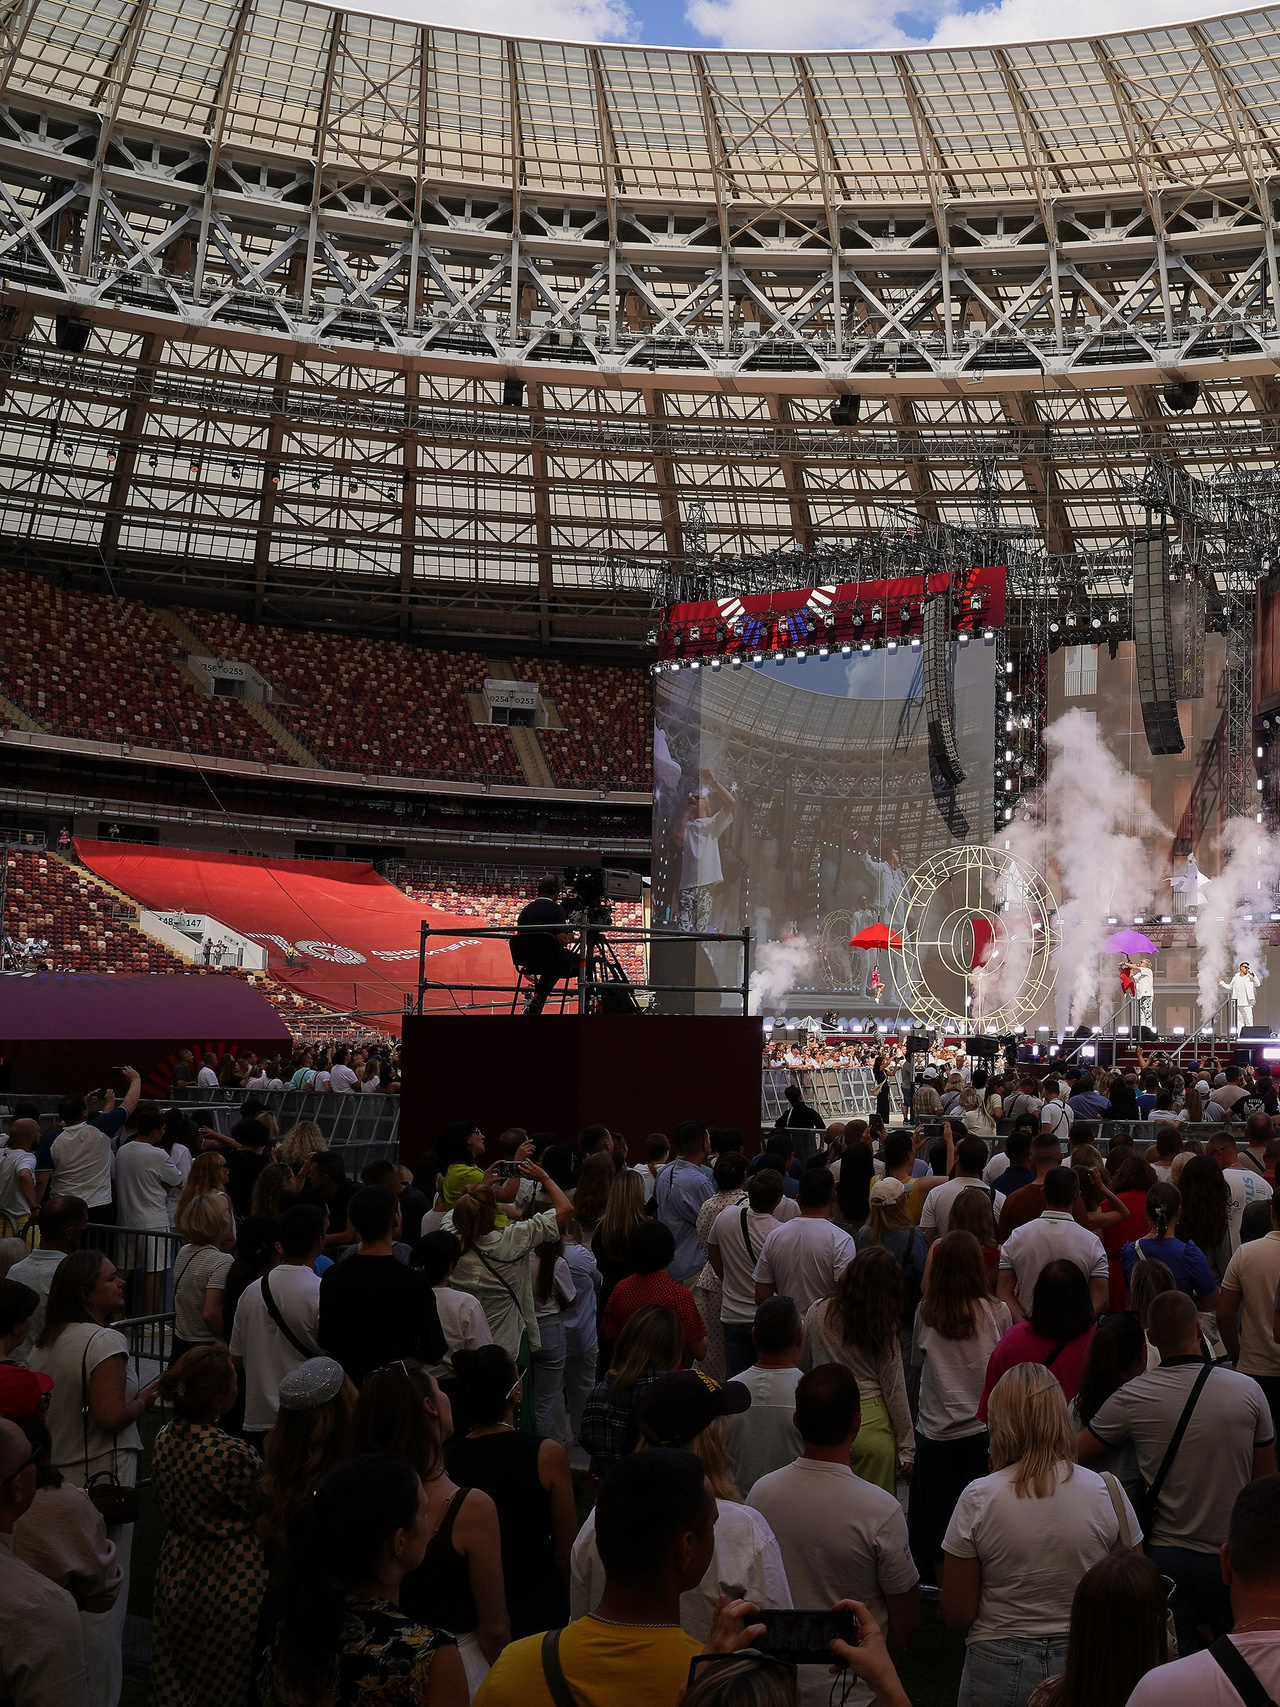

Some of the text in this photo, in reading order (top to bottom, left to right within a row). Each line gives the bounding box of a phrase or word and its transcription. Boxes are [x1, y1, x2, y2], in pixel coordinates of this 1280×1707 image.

[229, 667, 244, 676] 255
[495, 695, 509, 703] 254
[521, 697, 535, 705] 253
[186, 919, 202, 928] 147
[371, 949, 419, 957] ДЕНЬ
